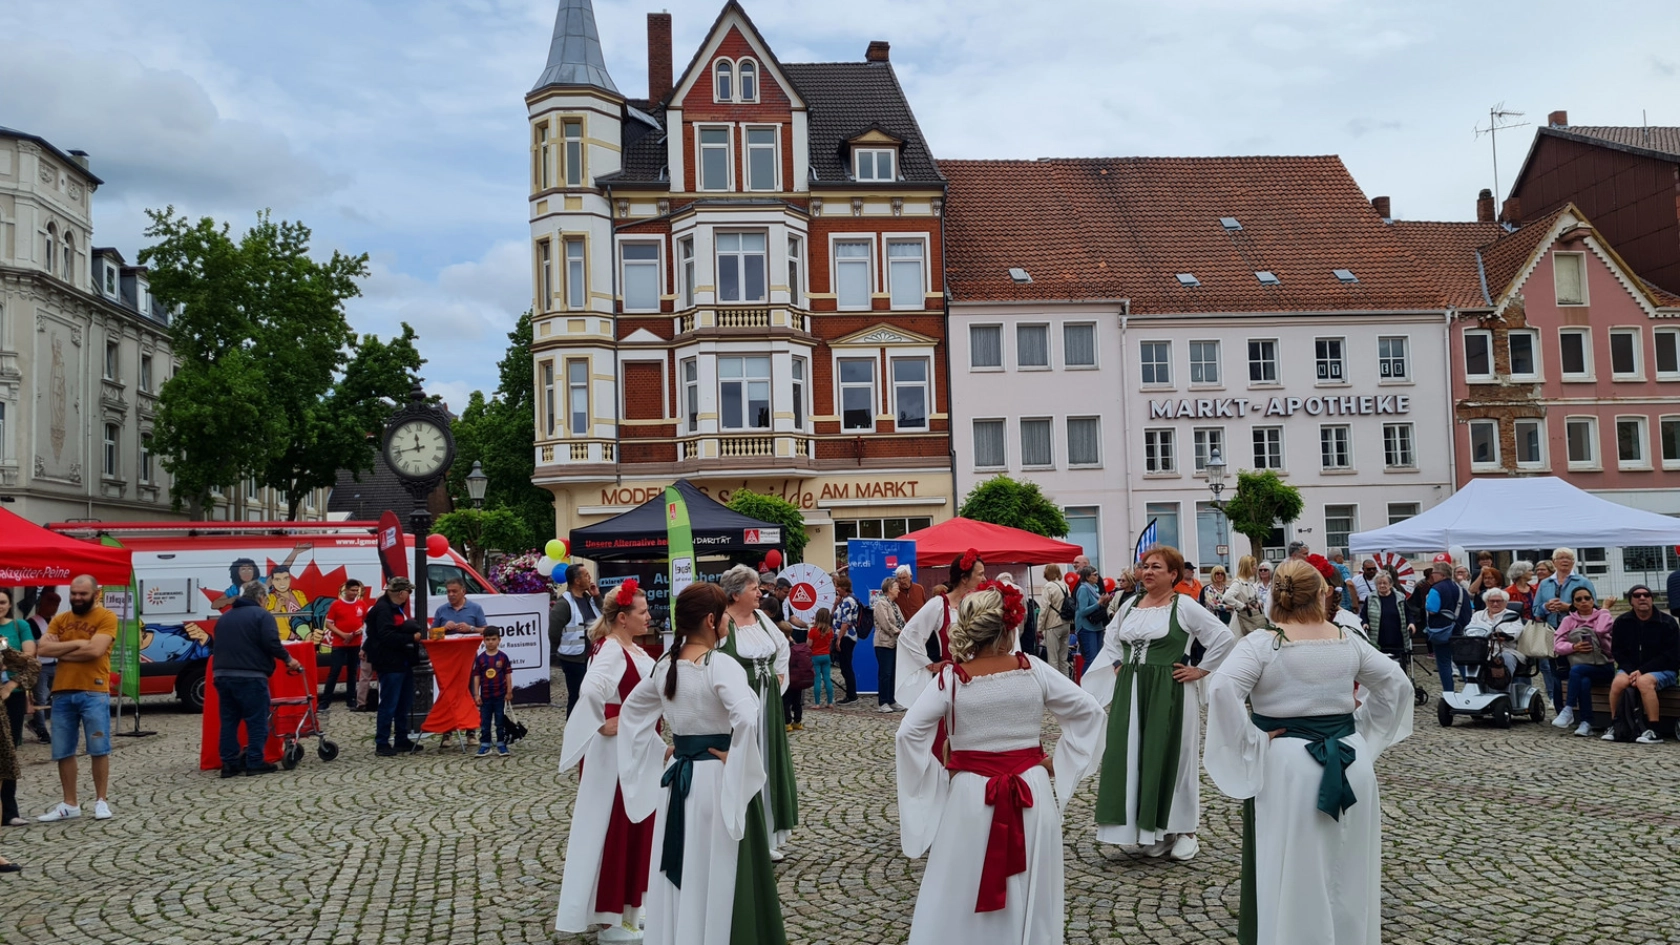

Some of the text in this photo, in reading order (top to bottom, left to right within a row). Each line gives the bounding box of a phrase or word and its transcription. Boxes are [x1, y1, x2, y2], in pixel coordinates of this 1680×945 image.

[1149, 395, 1410, 419] MARKT-APOTHEKE
[820, 483, 849, 499] AM
[856, 481, 918, 498] MARKT
